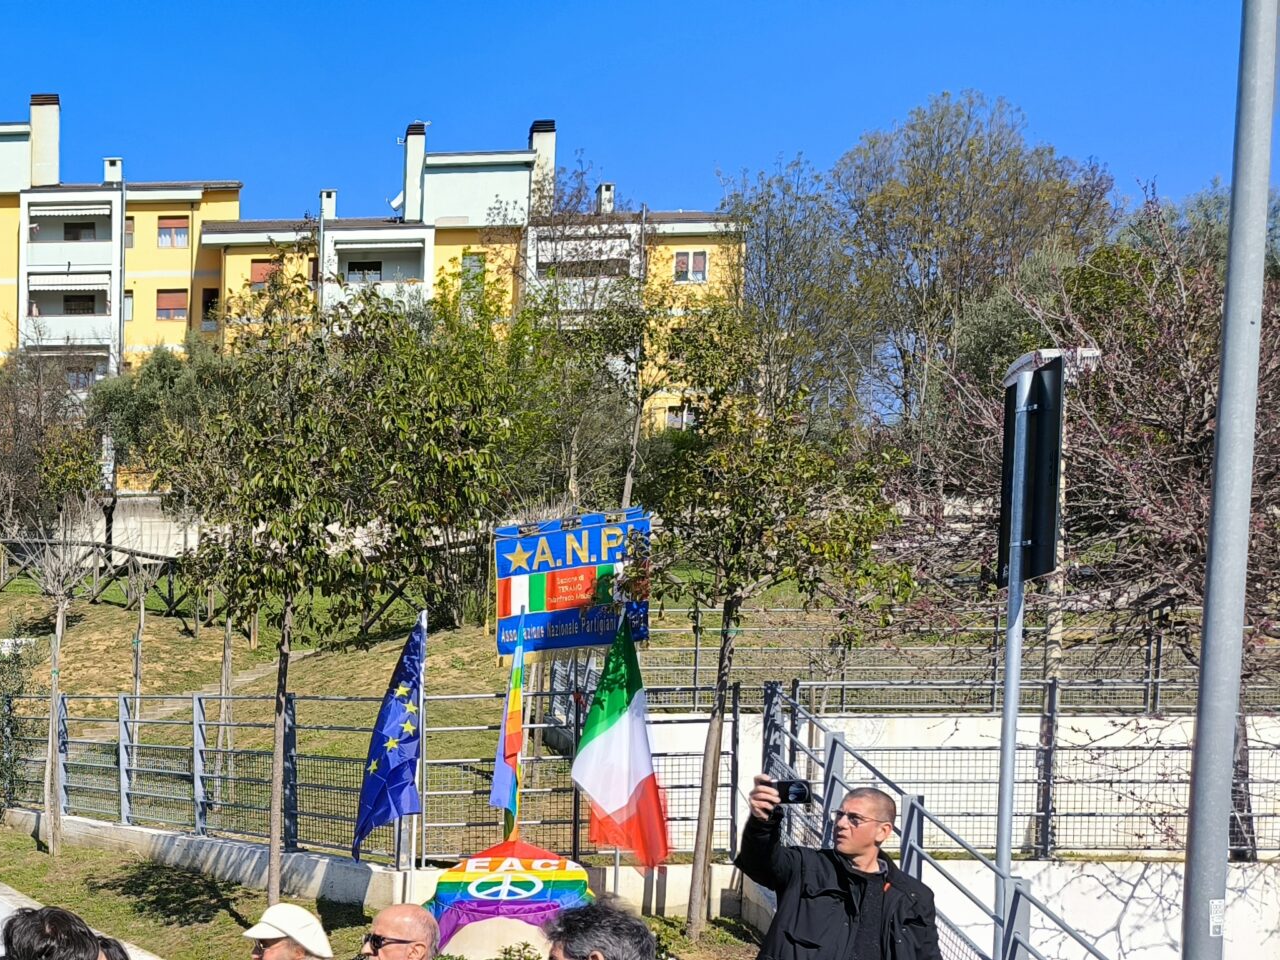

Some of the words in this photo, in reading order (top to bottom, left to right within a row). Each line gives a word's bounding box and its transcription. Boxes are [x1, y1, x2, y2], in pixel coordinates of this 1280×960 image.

[501, 625, 545, 643] Assoazione
[546, 618, 579, 637] Nazionale
[581, 616, 617, 635] Partigiani
